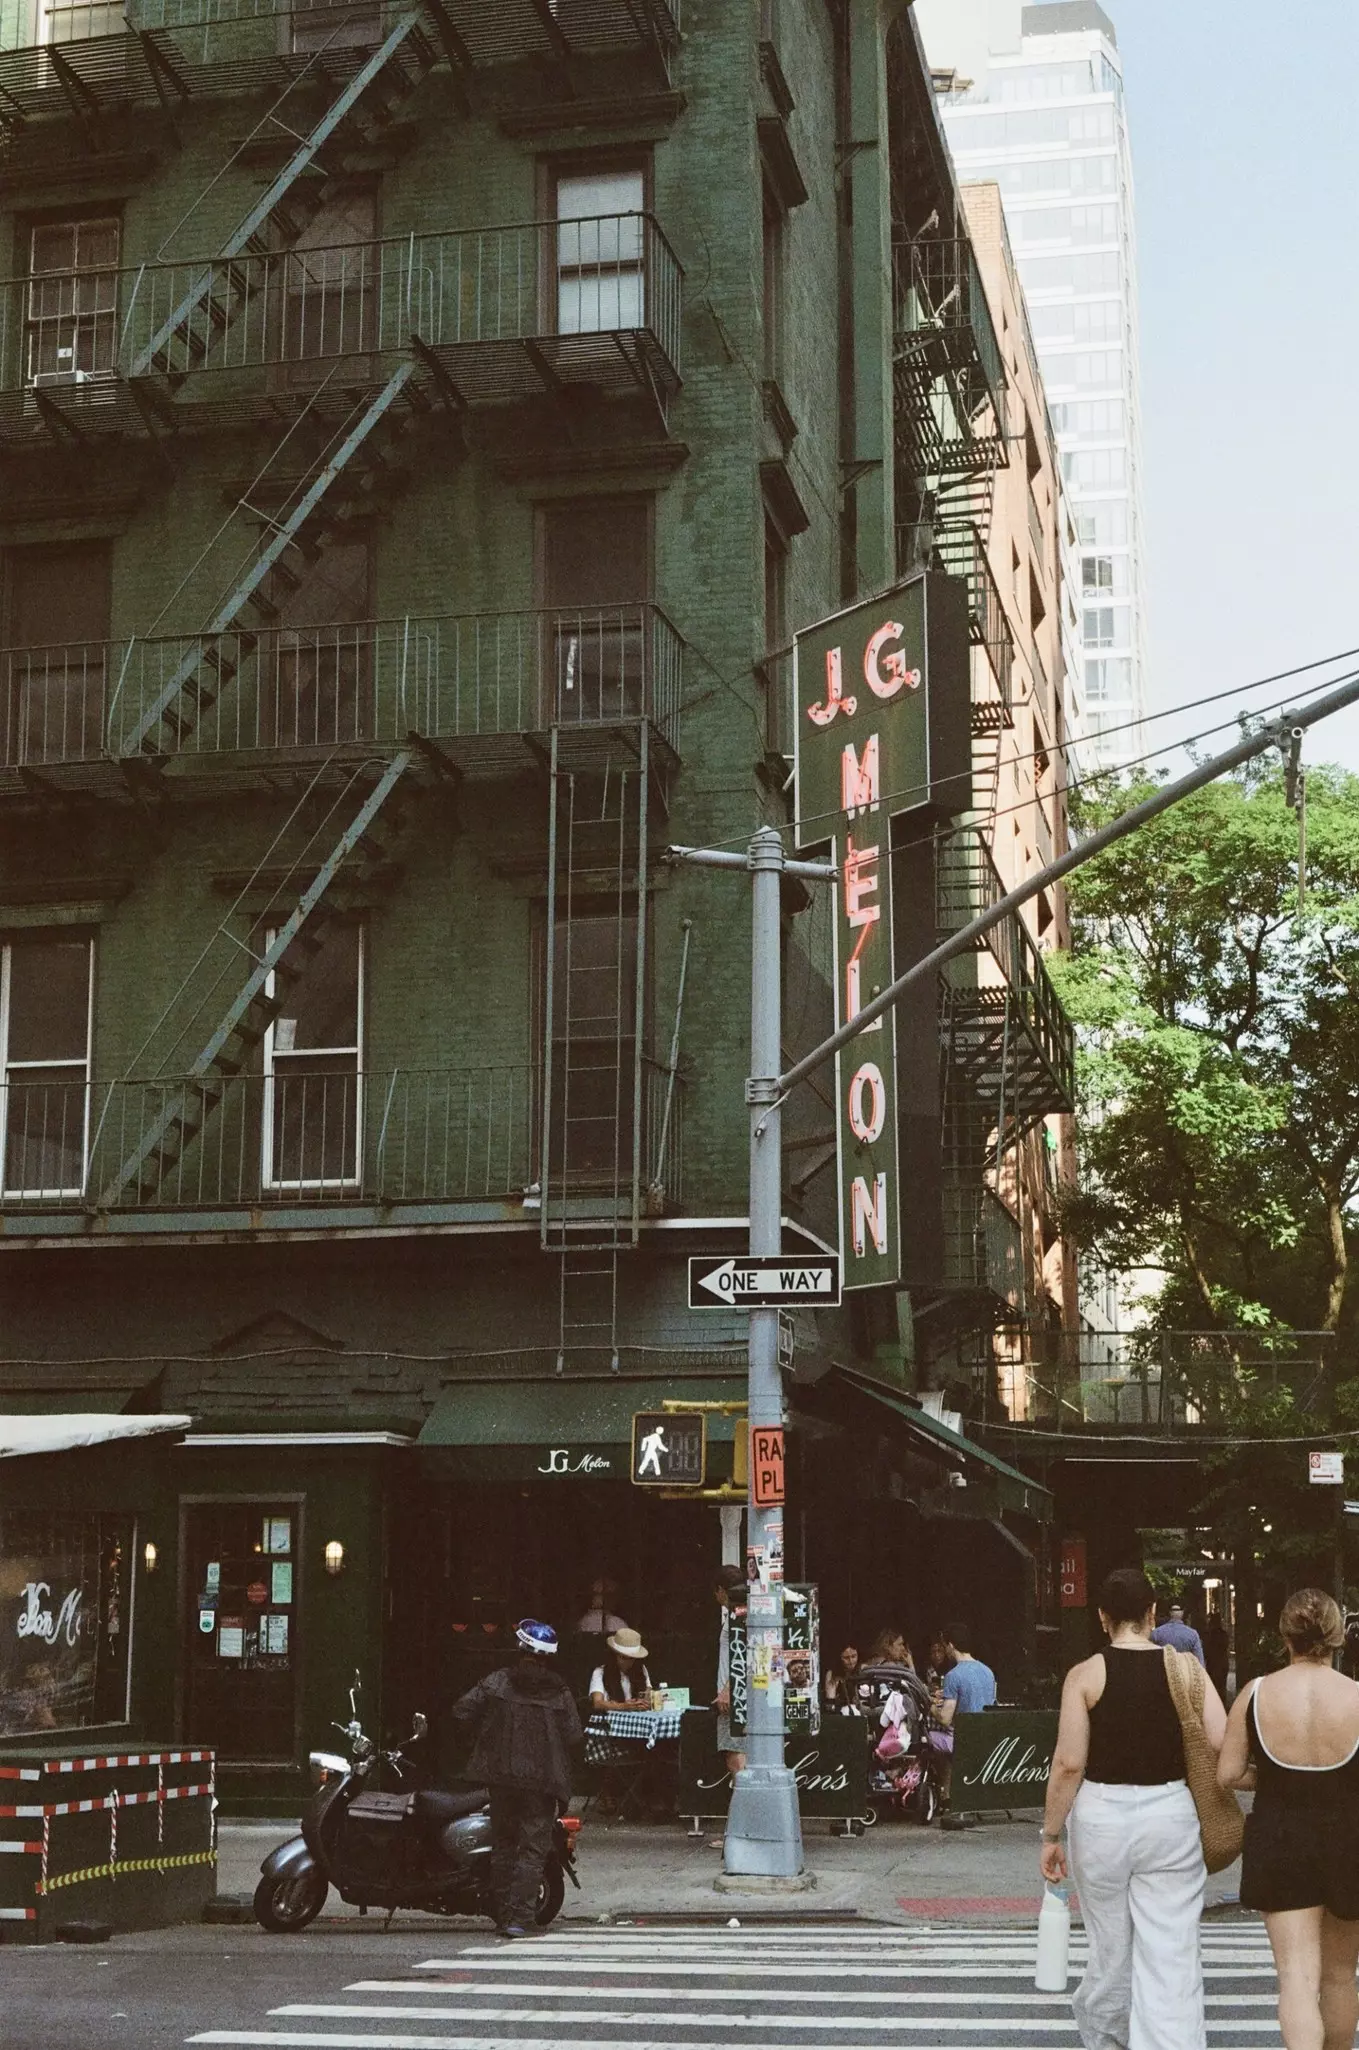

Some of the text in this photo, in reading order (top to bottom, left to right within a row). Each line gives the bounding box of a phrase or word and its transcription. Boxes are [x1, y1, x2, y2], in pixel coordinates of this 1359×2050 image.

[841, 733, 888, 1259] MELON
[718, 1271, 823, 1292] ONE WAY
[568, 1453, 611, 1473] Melon
[1175, 1567, 1207, 1577] Mayfair
[786, 1704, 809, 1719] GENIE
[963, 1736, 1051, 1785] Melon's
